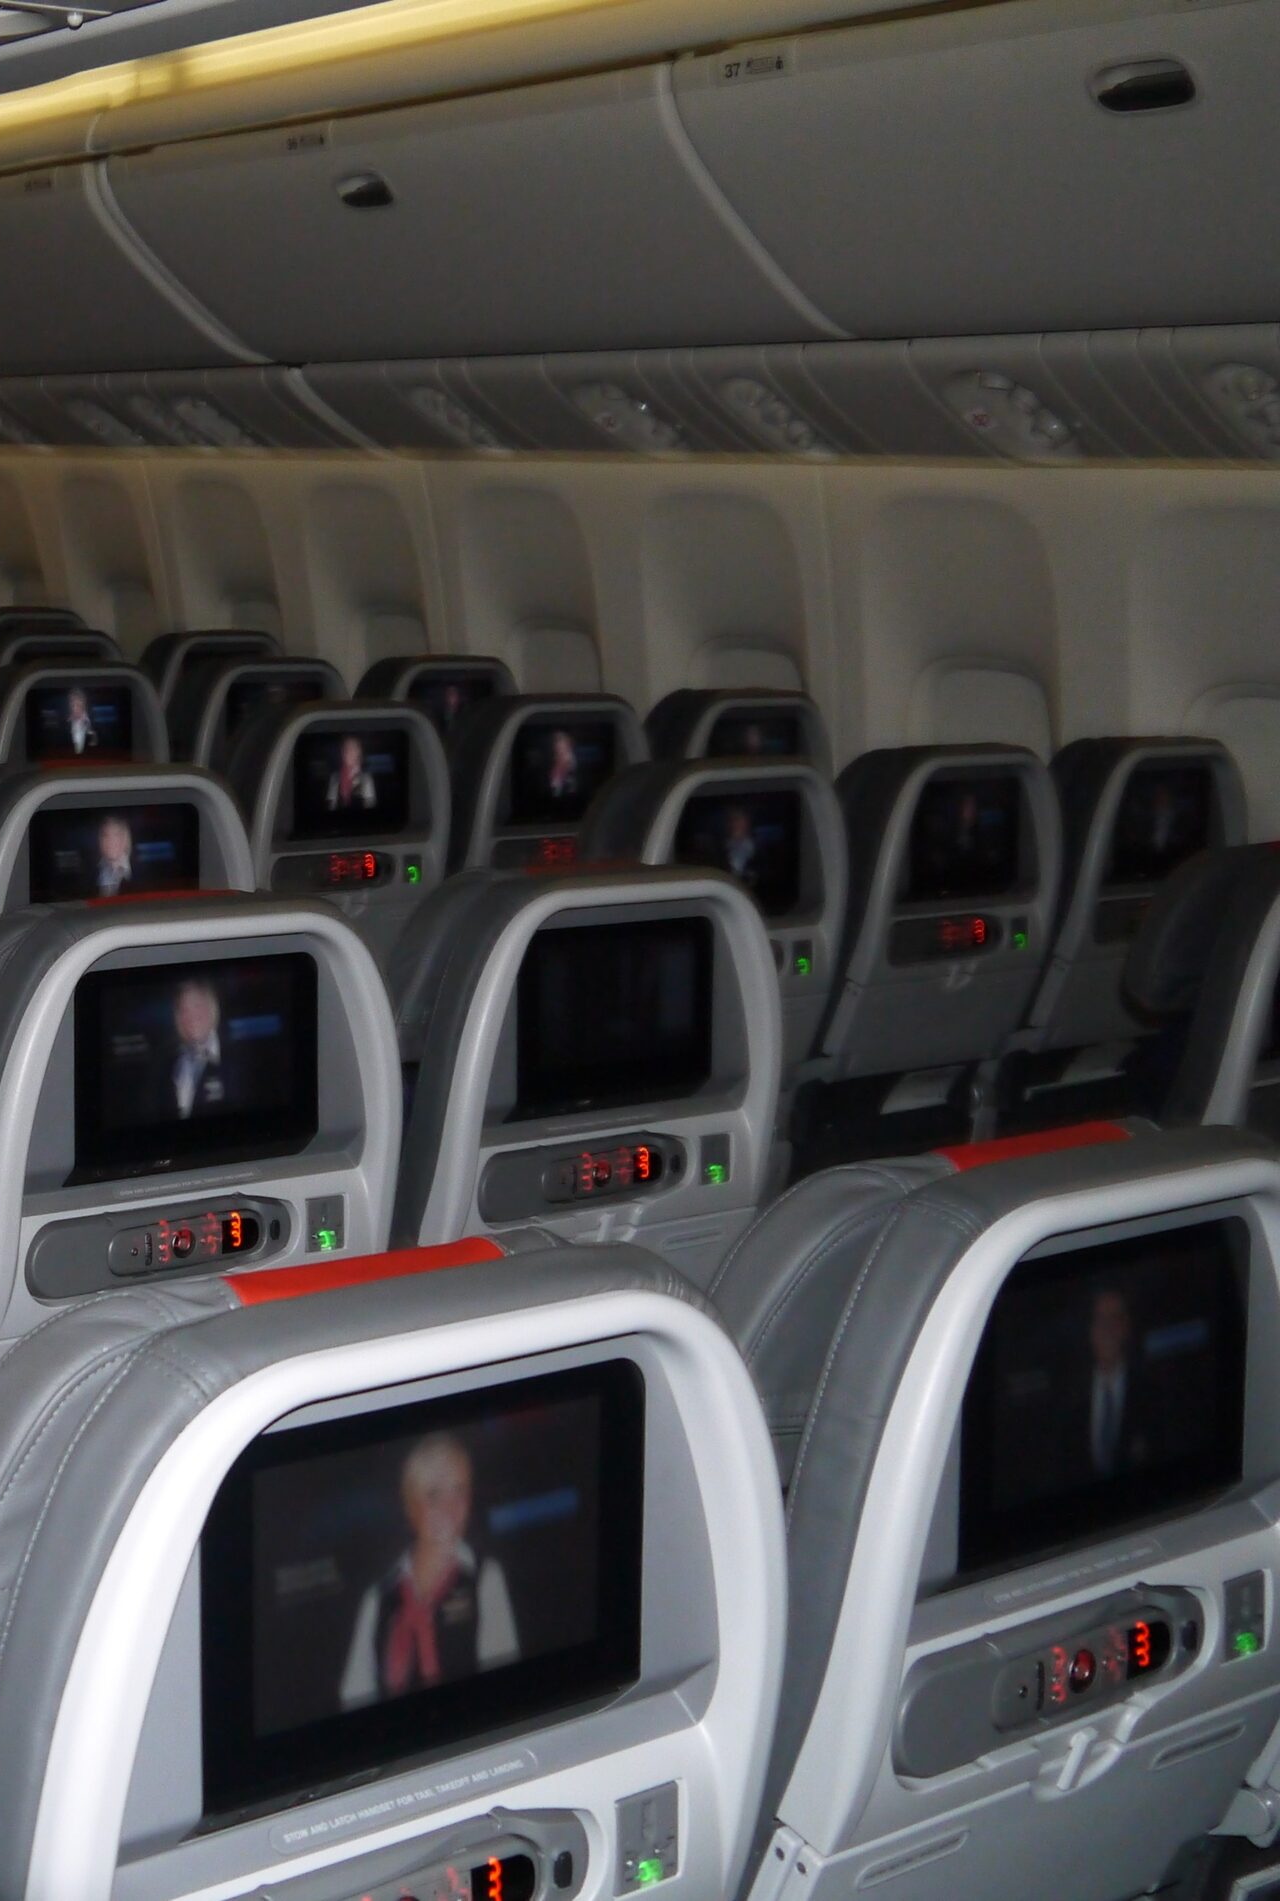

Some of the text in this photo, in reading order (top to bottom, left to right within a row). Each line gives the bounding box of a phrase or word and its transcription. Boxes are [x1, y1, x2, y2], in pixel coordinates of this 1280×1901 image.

[725, 62, 740, 78] 37
[283, 1829, 309, 1844] STOW
[310, 1822, 329, 1835] AND
[330, 1813, 357, 1829] LATCH
[358, 1800, 397, 1821] HANDSET
[396, 1795, 416, 1809] FOR
[435, 1776, 470, 1795] TAKEOFF
[471, 1771, 489, 1784] AND
[489, 1760, 524, 1777] LANDING
